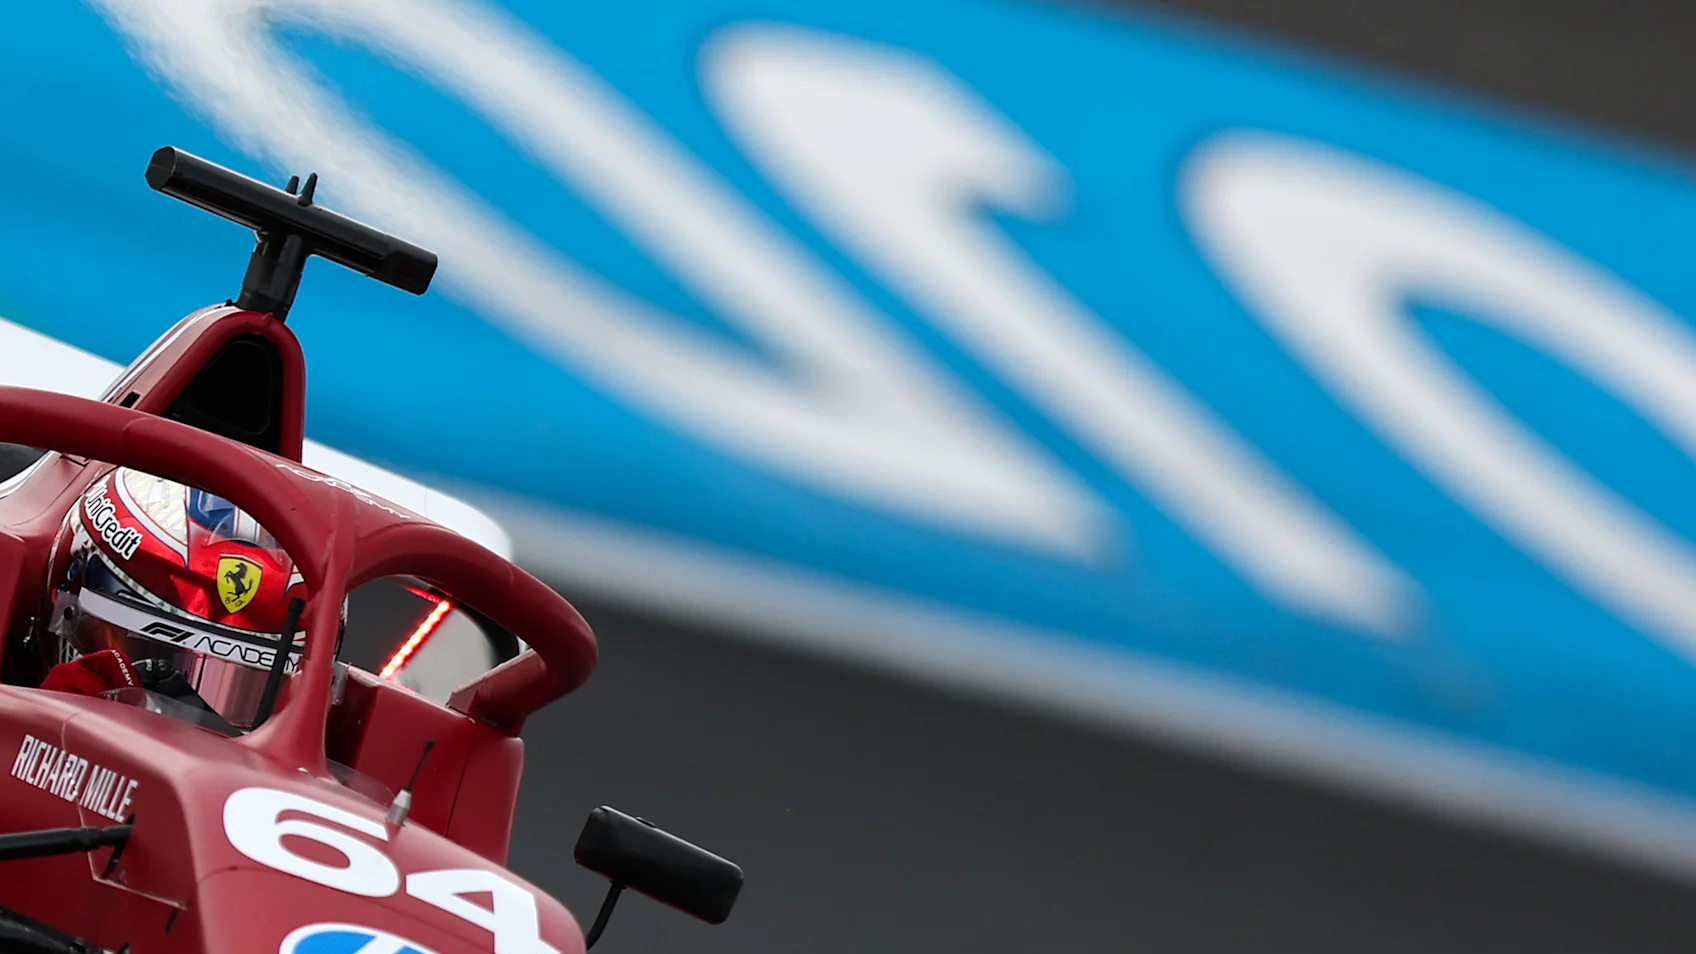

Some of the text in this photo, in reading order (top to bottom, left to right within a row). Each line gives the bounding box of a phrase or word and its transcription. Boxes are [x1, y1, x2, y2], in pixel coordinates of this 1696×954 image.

[86, 484, 141, 558] UniCredit
[140, 621, 300, 674] F1 ACADEY
[10, 733, 139, 824] RICHARD MILLE
